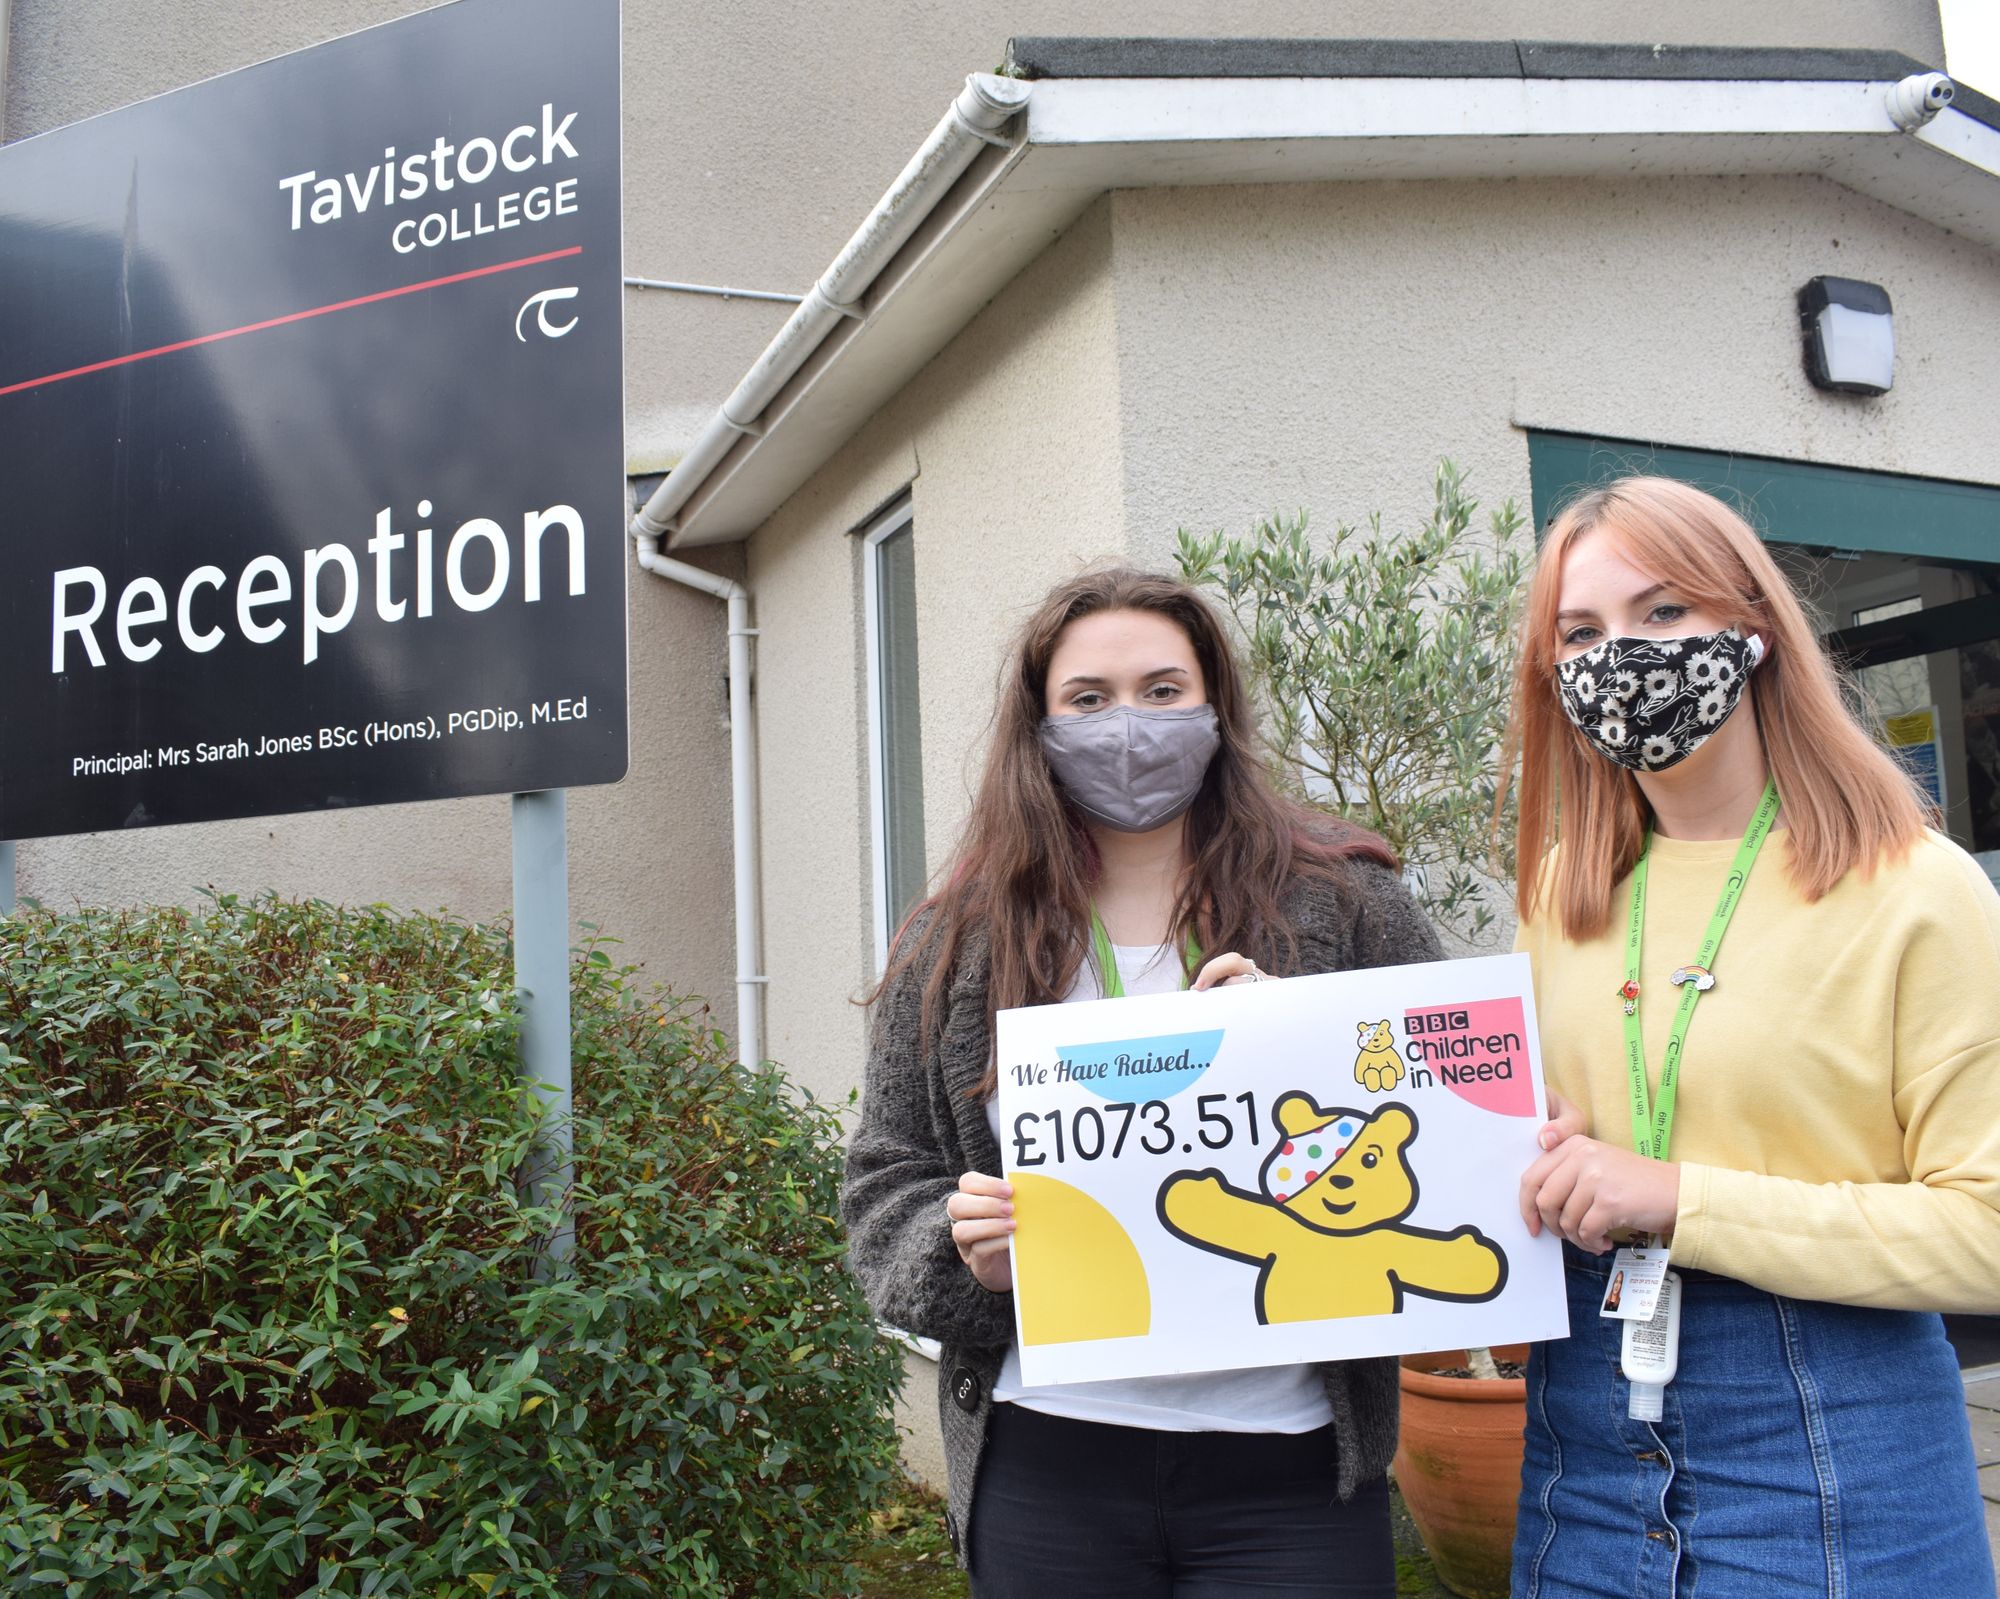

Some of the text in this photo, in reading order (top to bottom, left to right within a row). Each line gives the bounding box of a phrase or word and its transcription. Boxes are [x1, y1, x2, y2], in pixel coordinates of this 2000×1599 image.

[278, 102, 579, 231] Tavistock
[391, 178, 579, 254] COLLEGE
[52, 499, 586, 673] Reception
[72, 696, 588, 777] Principal: Mrs Sarah Jones BSc (Hons), PGDip, M.Ed
[1746, 820, 1766, 848] Prefect
[1405, 1012, 1468, 1034] BBC
[1405, 1032, 1520, 1063] Children
[1010, 1048, 1211, 1087] We Have Raised...
[1410, 1056, 1513, 1089] in Need
[1630, 1040, 1644, 1116] 6th Form Prefect
[1012, 1091, 1260, 1167] £1073.51
[1658, 1111, 1667, 1126] 6th
[1653, 1128, 1665, 1153] Form
